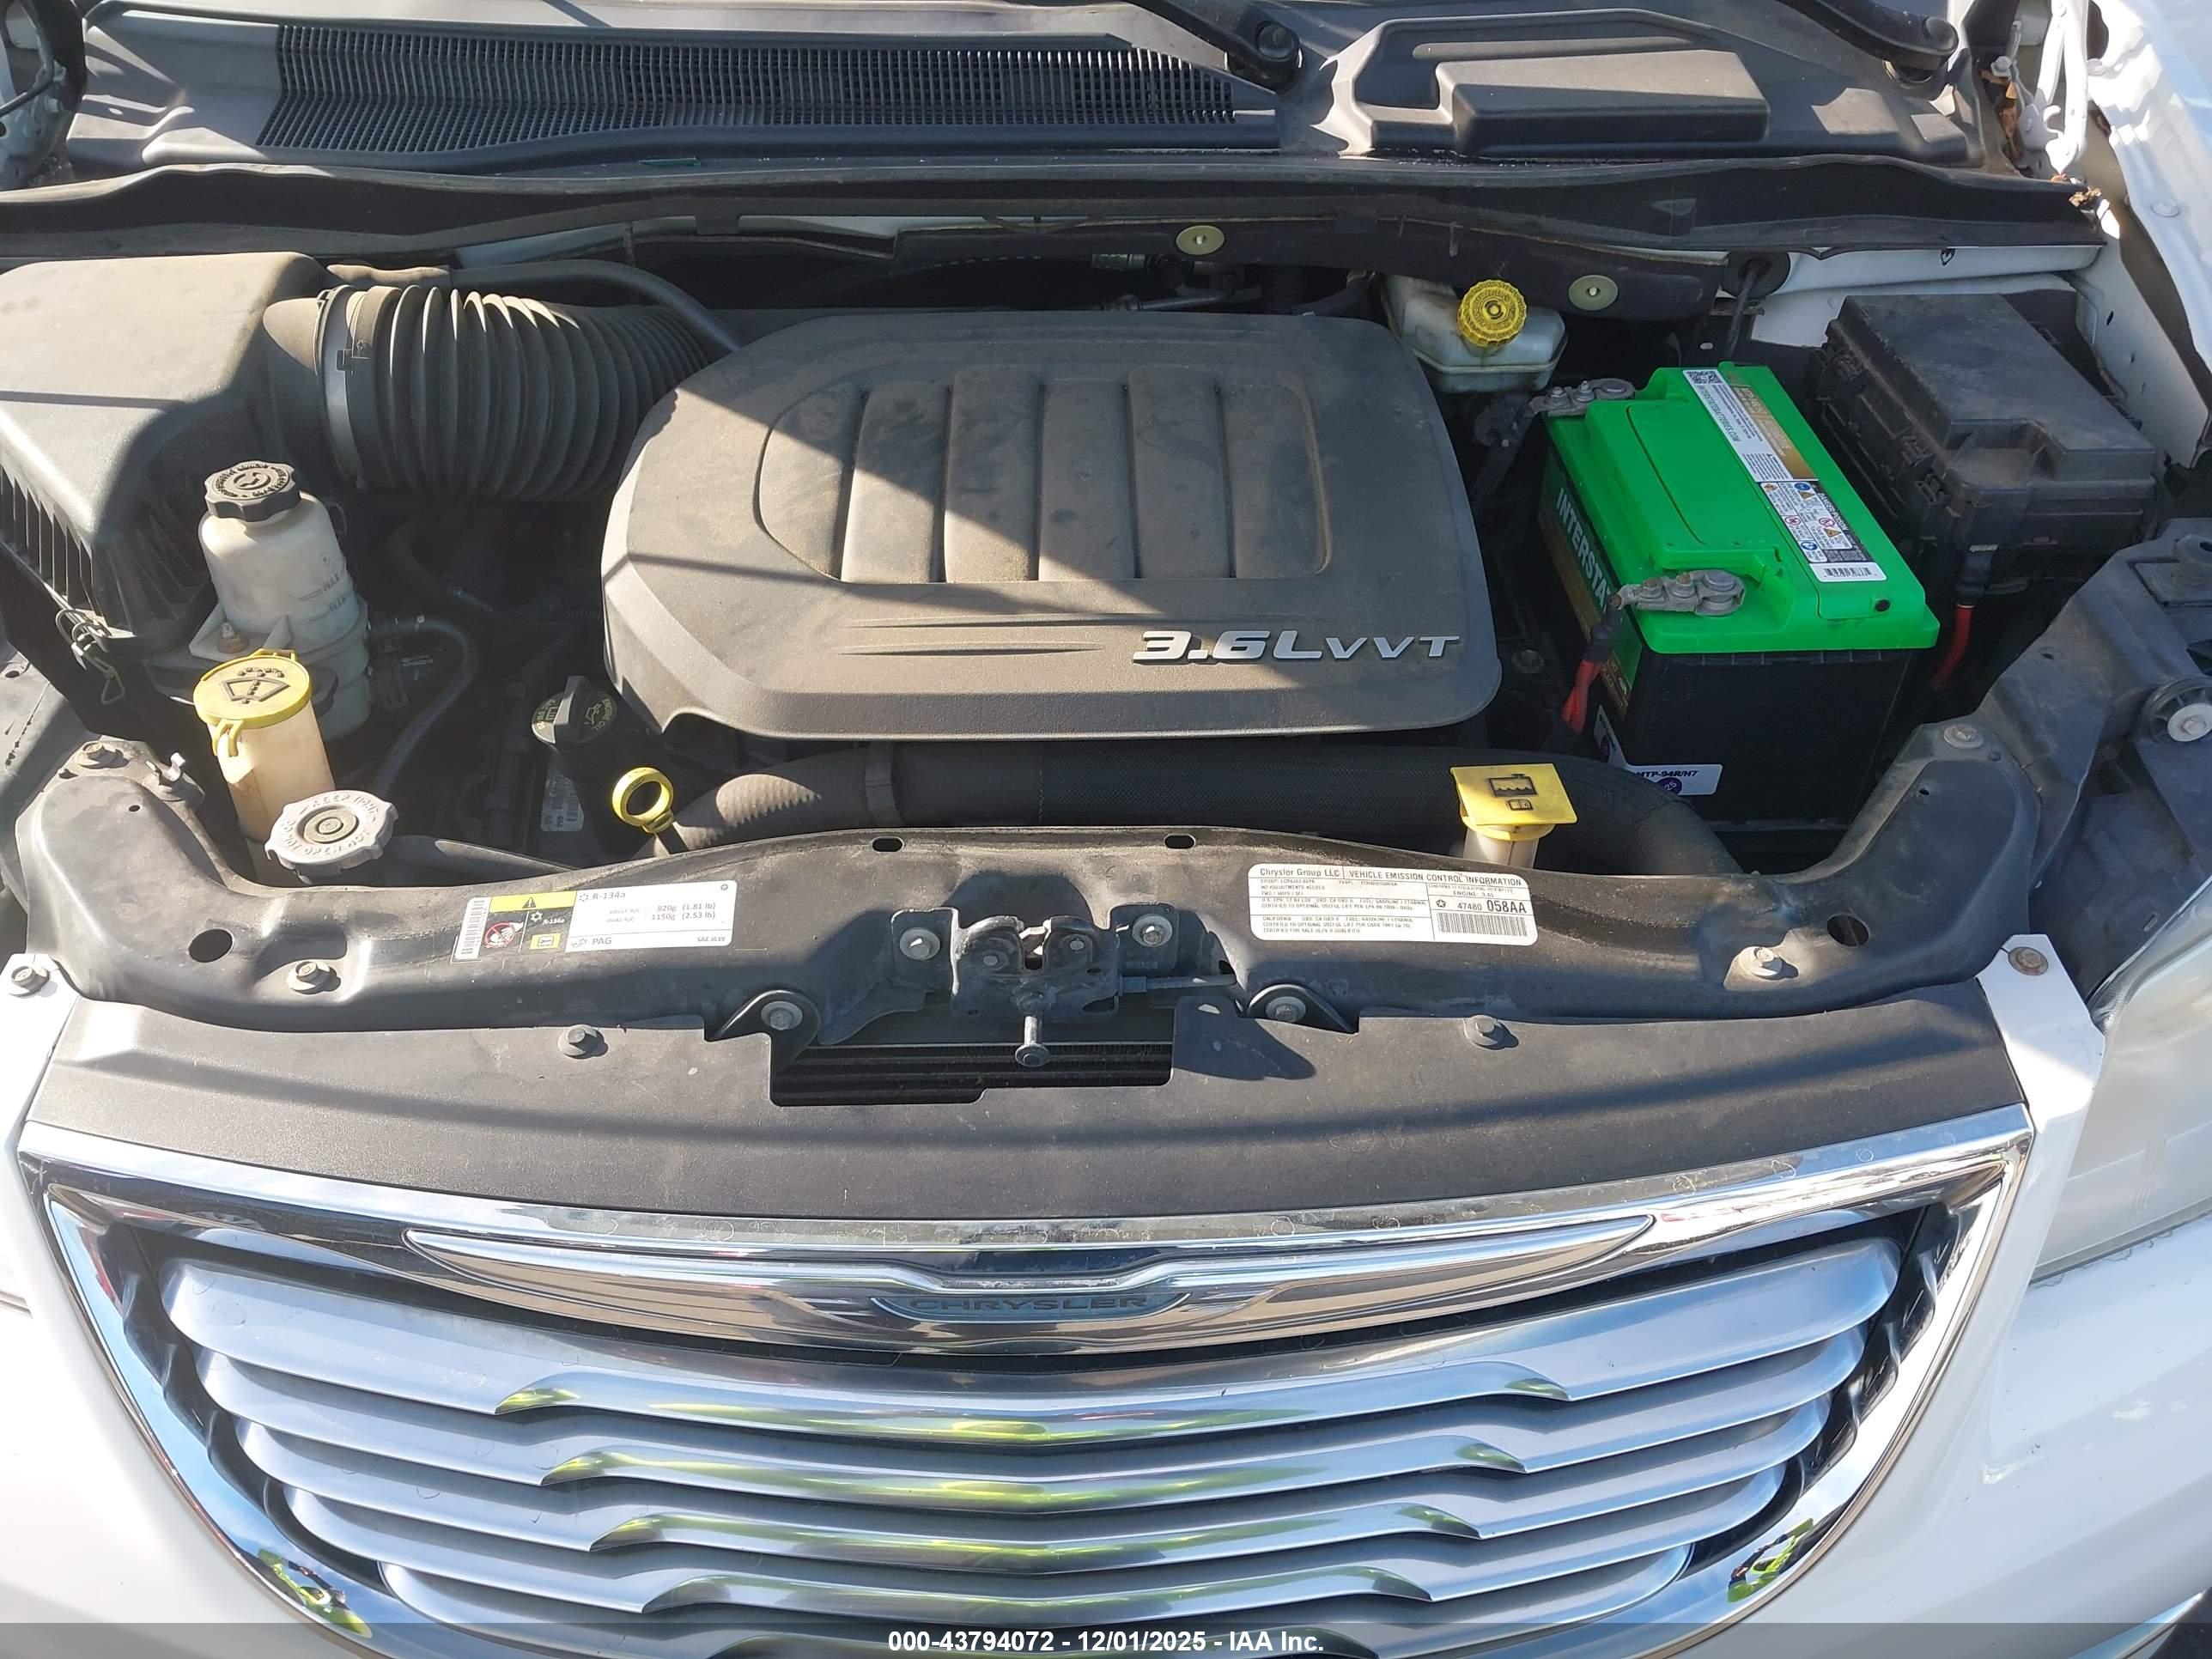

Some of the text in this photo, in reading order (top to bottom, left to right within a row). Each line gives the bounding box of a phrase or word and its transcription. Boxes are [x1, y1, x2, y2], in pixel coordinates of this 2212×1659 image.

[1133, 630, 1459, 661] 3.6L VVT
[1260, 868, 1294, 877] Chrysler
[1297, 868, 1322, 877] Group
[1349, 870, 1522, 886] VEHICLE EMISSION CONTROL INFORMATION
[592, 891, 626, 900] R-134a
[705, 902, 716, 910] lb)
[1486, 900, 1527, 914] 058AA
[682, 912, 702, 921] (2.53
[705, 910, 716, 920] lb)
[909, 1297, 1149, 1311] CHRYSLER
